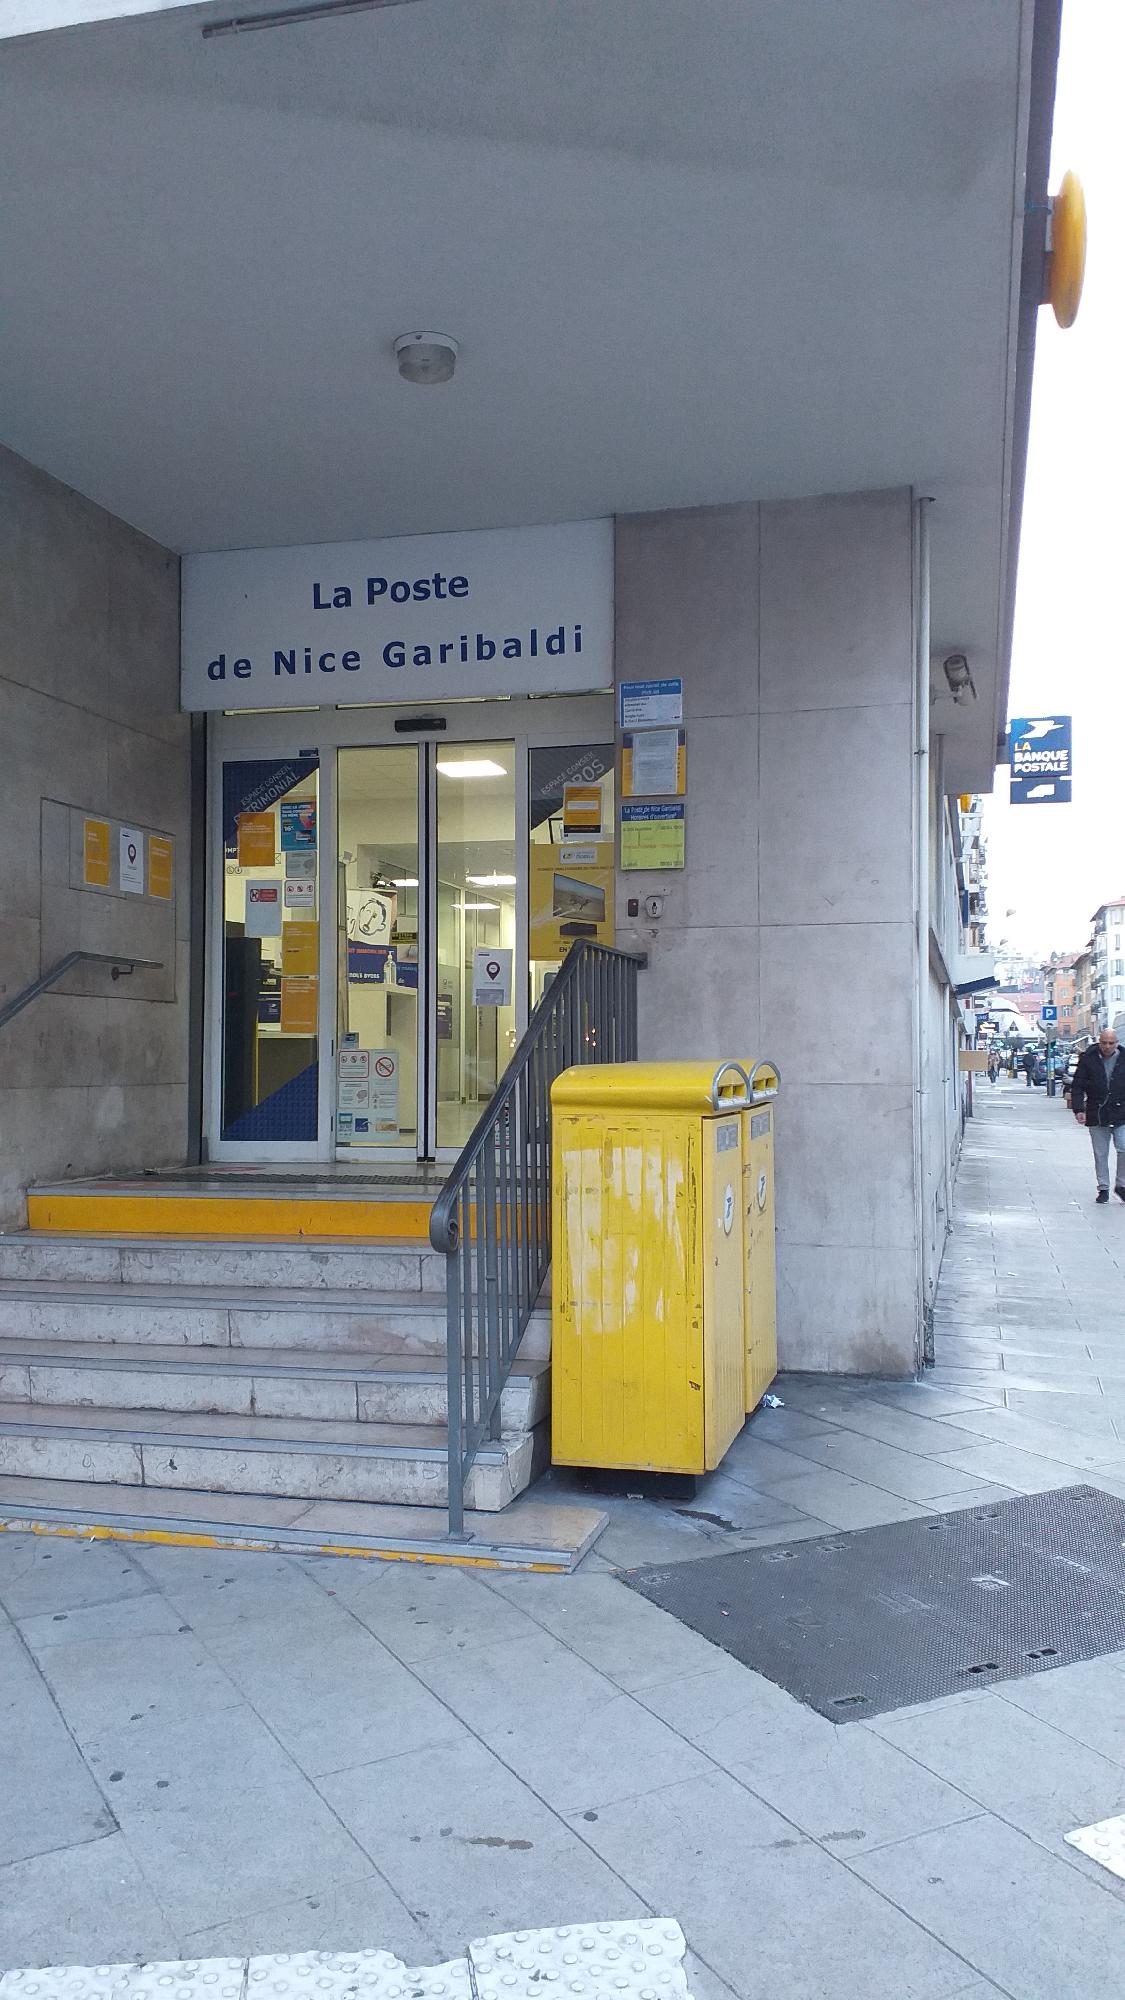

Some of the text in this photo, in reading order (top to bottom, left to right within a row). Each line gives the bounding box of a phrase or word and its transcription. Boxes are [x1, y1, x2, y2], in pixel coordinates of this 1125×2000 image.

[313, 572, 470, 609] La Poste
[207, 624, 583, 681] de Nice Garibaldi
[1014, 742, 1031, 751] LA
[1014, 750, 1068, 762] BANQUE
[241, 764, 293, 806] ESPACE CONSEIL
[541, 772, 567, 795] ESPACE
[566, 751, 594, 775] CONSEIL
[1014, 761, 1068, 773] POSTALE
[234, 772, 301, 825] PTRIMONIAL
[1045, 1008, 1054, 1019] P
